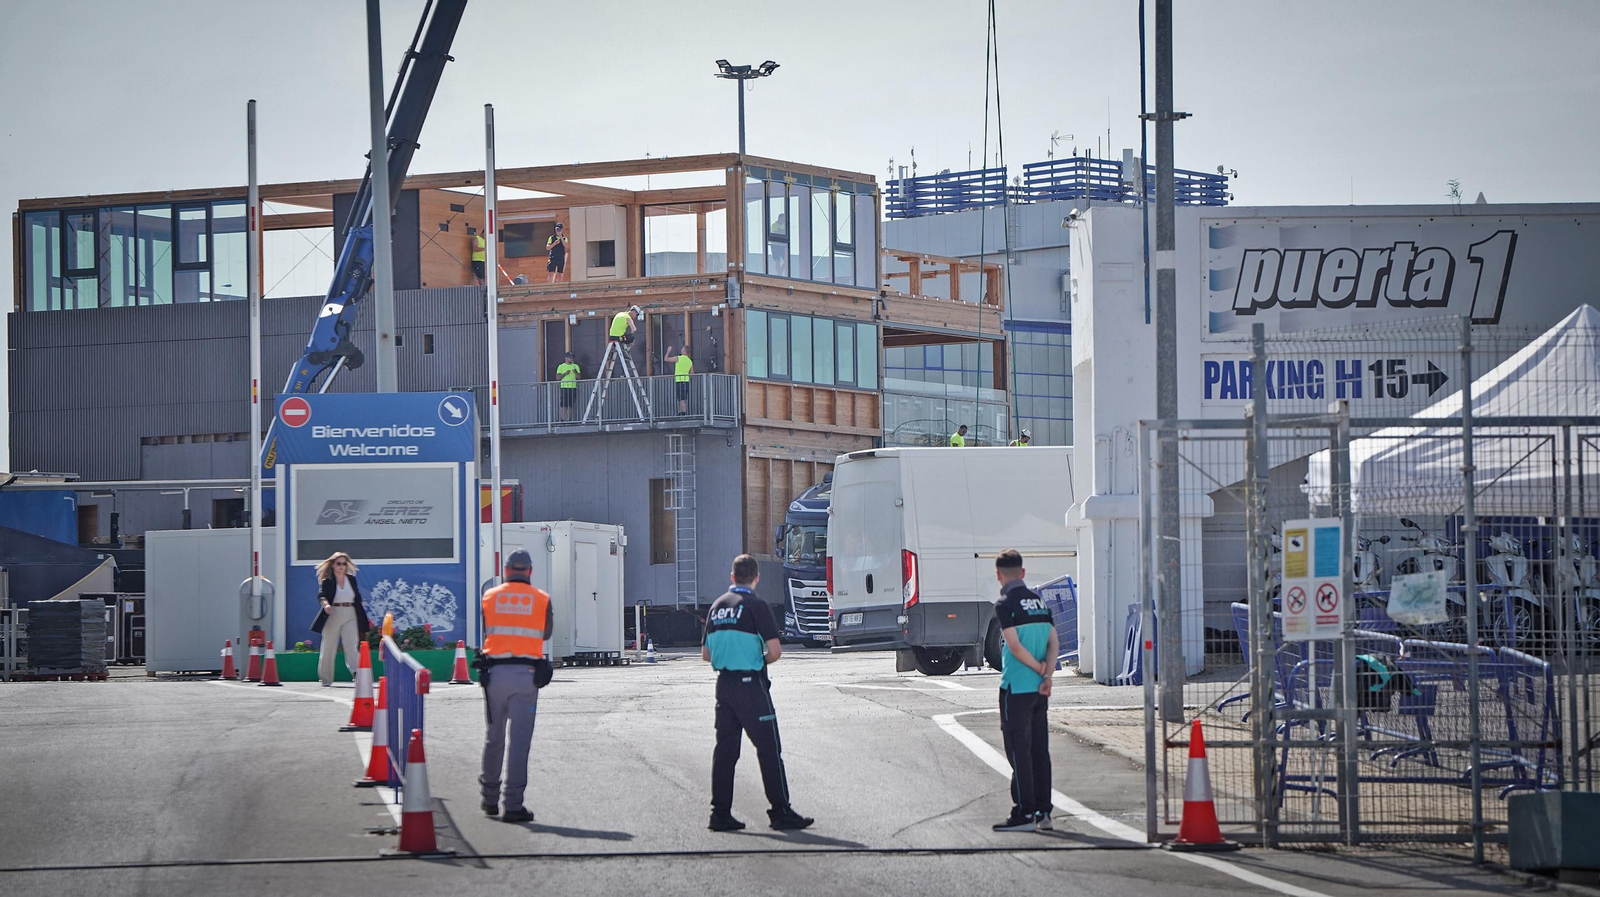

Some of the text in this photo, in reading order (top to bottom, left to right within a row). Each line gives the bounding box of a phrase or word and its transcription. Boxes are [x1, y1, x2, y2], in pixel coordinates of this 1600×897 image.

[1232, 229, 1519, 324] puerta 1
[1203, 359, 1409, 400] PARKING H 15
[312, 425, 436, 438] Bienvenidos
[329, 444, 419, 456] Welcome
[368, 506, 434, 516] JEREZ
[364, 517, 396, 525] ÁNGEL
